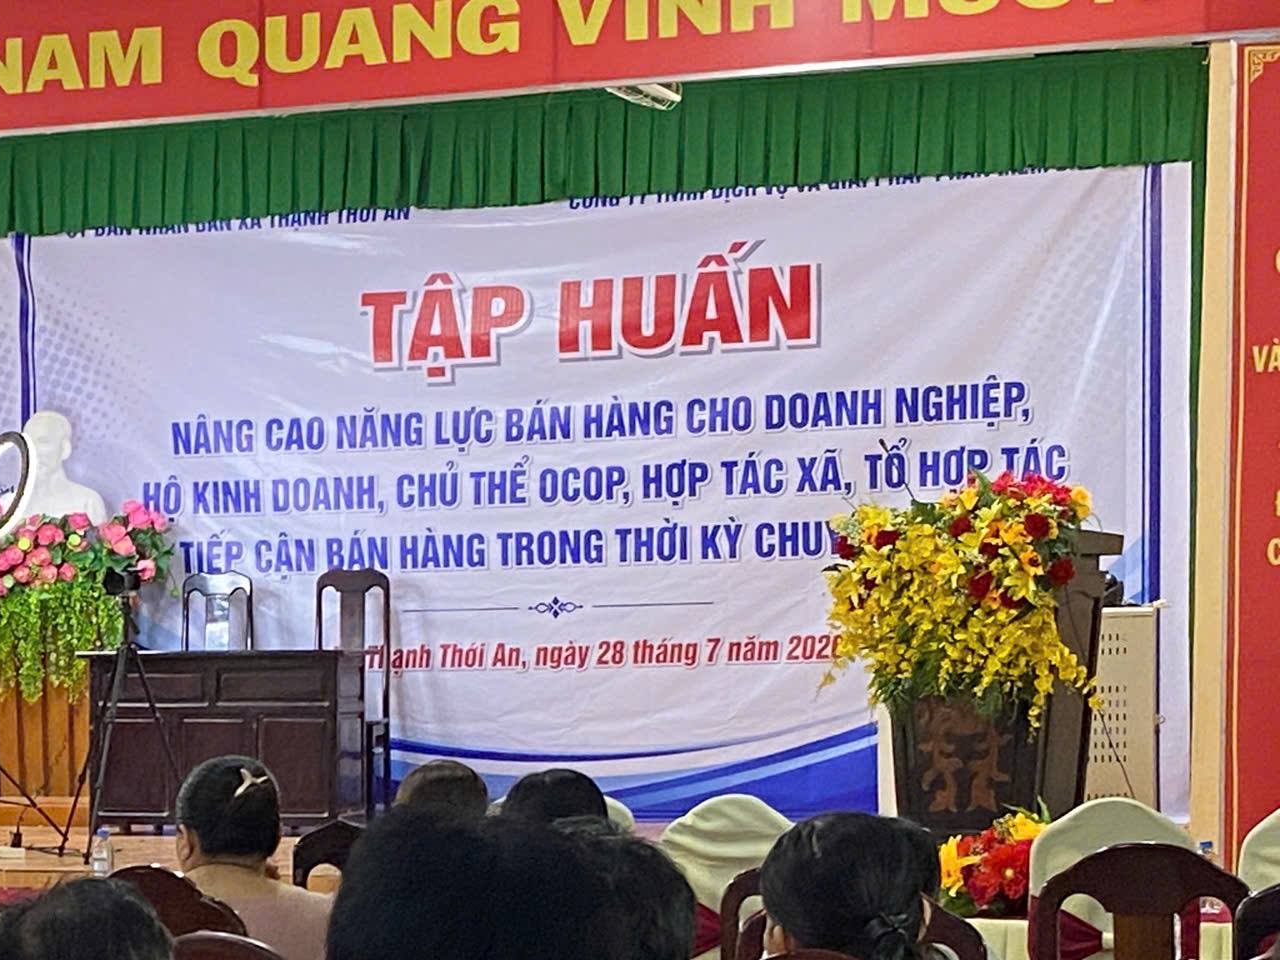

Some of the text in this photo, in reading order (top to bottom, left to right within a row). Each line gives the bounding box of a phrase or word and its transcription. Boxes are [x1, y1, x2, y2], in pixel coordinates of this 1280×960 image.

[197, 0, 520, 87] QUANG
[360, 239, 816, 381] TẬP HUẤN
[171, 375, 1032, 455] NÂNG CAO NĂNG LỰC BÁN HÀNG CHO DOANH NGHIỆP,
[143, 437, 1066, 523] HỘ KINH DOANH, CHỦ THỂ OCOP, HỢP TÁC XÃ, TỔ HỢP TÁC
[180, 530, 243, 574] TIẾP
[255, 532, 315, 580] CẬN
[326, 529, 388, 570] BÁN
[400, 527, 486, 570] HÀNG
[497, 526, 604, 569] TRONG
[616, 517, 688, 563] THỜI
[701, 516, 741, 561] KỲ
[440, 643, 486, 668] Thới
[492, 642, 527, 672] An,
[535, 642, 589, 670] ngày
[596, 640, 624, 666] 28
[632, 637, 697, 670] tháng
[705, 638, 722, 664] 7
[728, 635, 780, 662] năm
